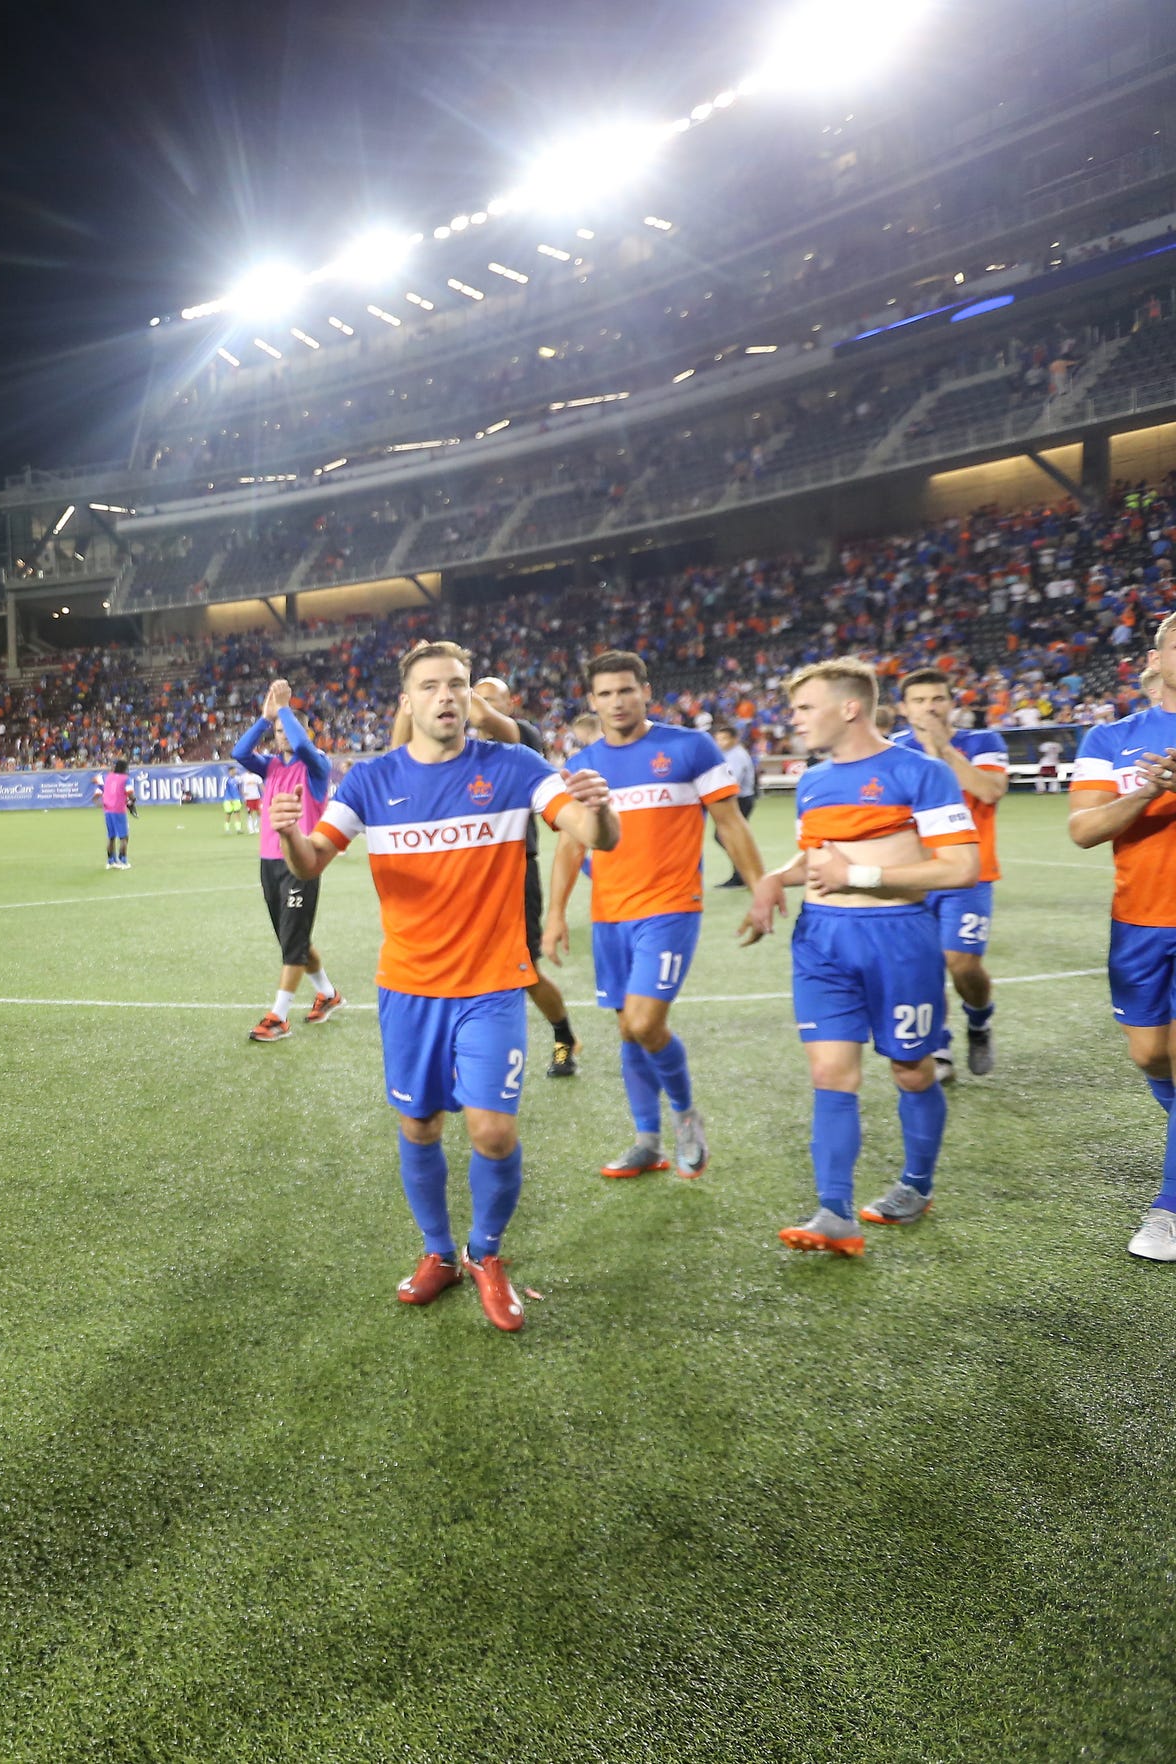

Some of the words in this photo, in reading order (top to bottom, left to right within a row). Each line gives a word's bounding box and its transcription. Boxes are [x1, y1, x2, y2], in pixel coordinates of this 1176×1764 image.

[610, 788, 672, 806] YOTA
[388, 821, 495, 849] TOYOTA
[287, 895, 304, 908] 22
[659, 950, 683, 984] 11
[893, 1003, 934, 1040] 20
[505, 1048, 524, 1090] 2
